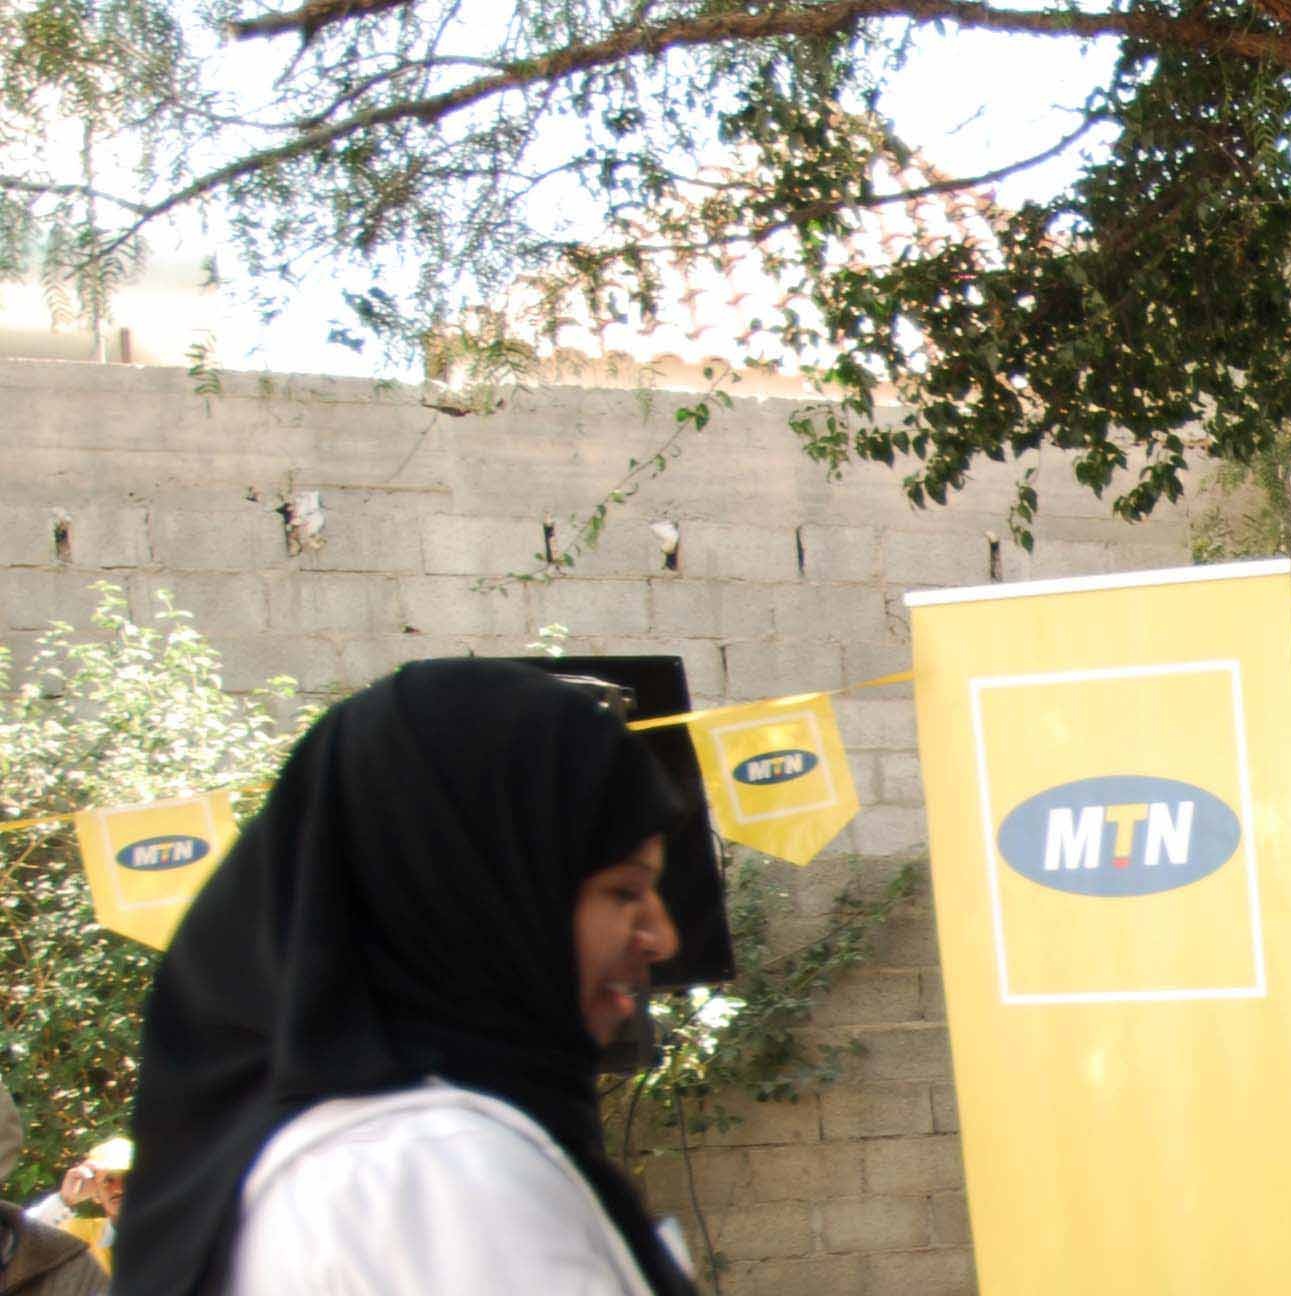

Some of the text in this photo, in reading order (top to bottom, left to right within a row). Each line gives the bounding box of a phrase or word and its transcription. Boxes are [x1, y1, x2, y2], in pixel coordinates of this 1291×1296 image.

[748, 753, 804, 782] MTN
[1043, 801, 1194, 872] MTN
[133, 839, 194, 867] MTN
